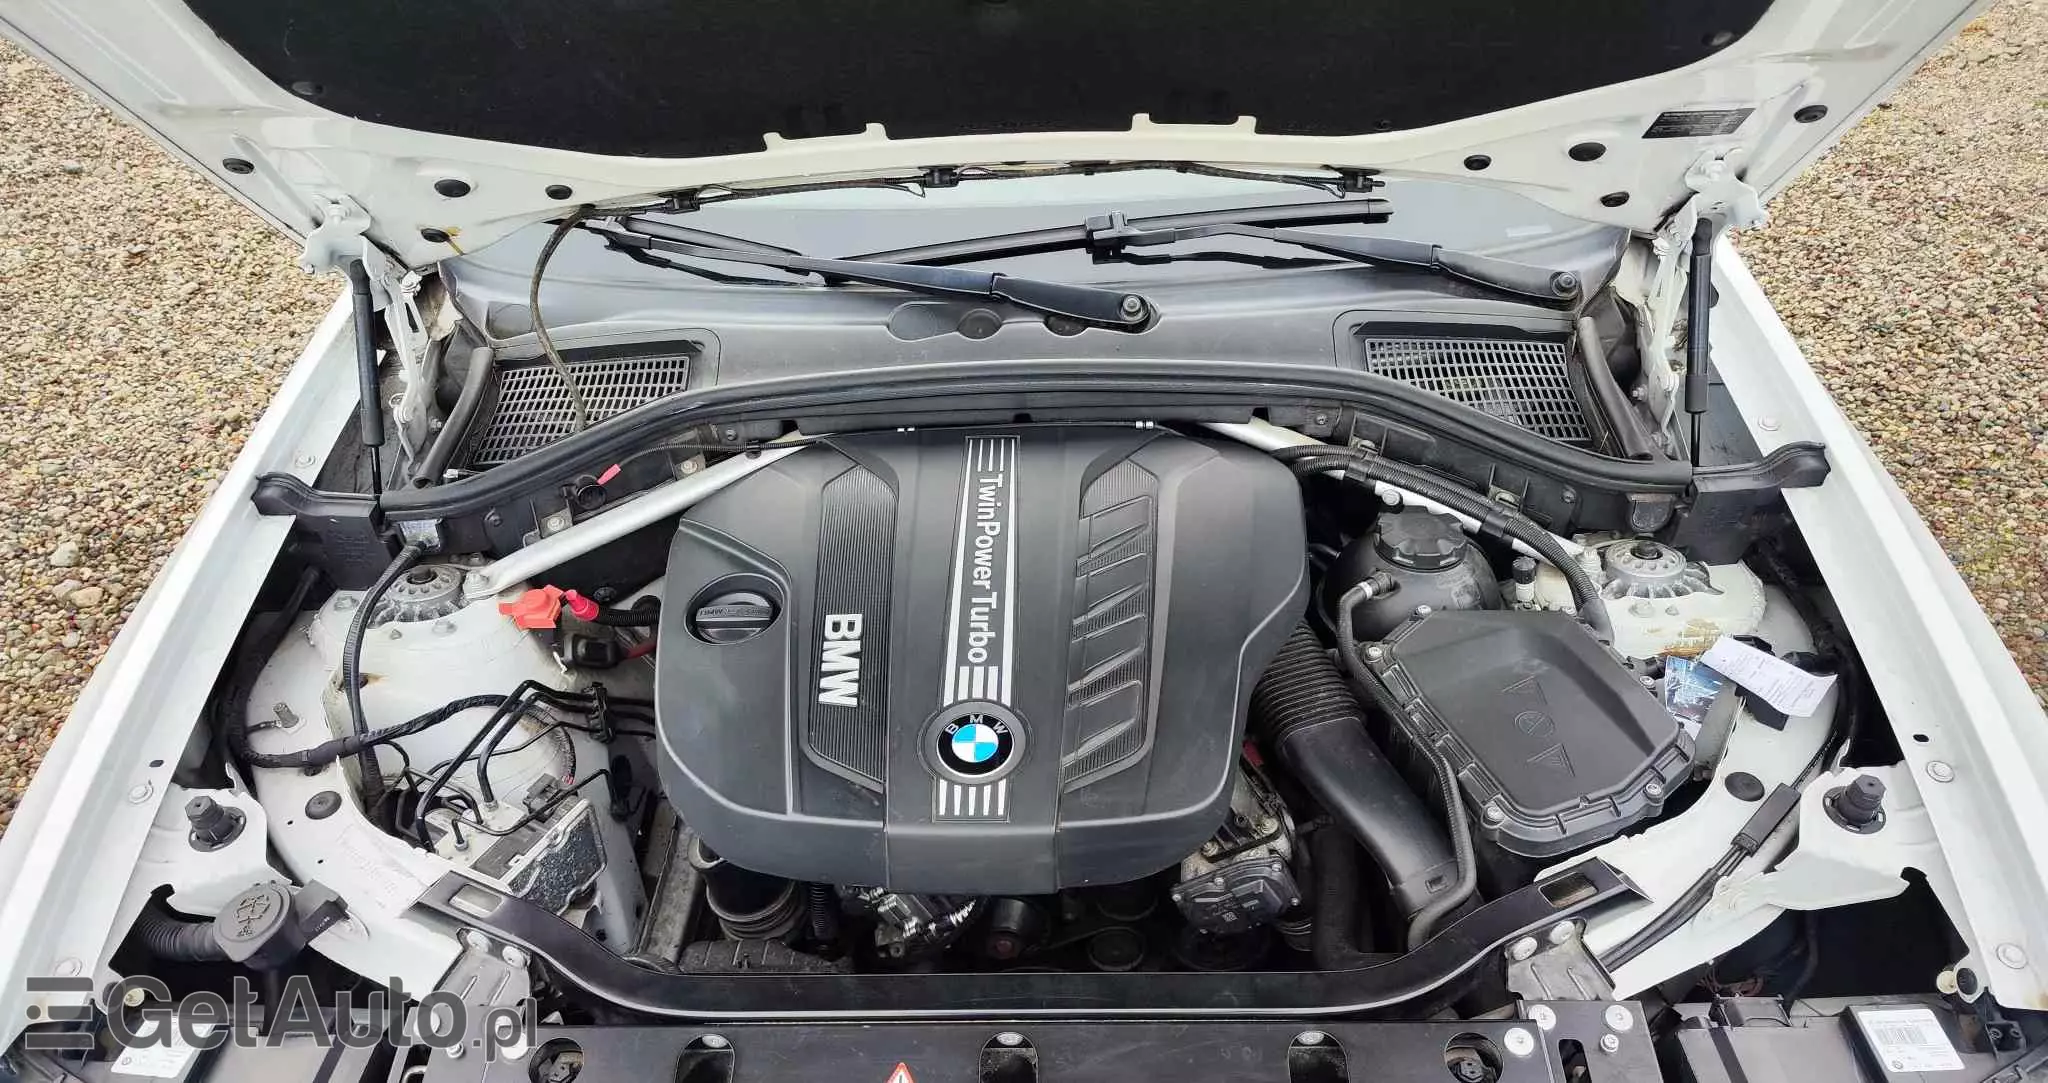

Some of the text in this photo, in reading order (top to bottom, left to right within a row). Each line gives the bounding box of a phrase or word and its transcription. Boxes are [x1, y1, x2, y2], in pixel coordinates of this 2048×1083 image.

[967, 473, 1003, 664] TwinPower Turbo
[818, 613, 863, 707] BMW
[944, 714, 1009, 735] BMW
